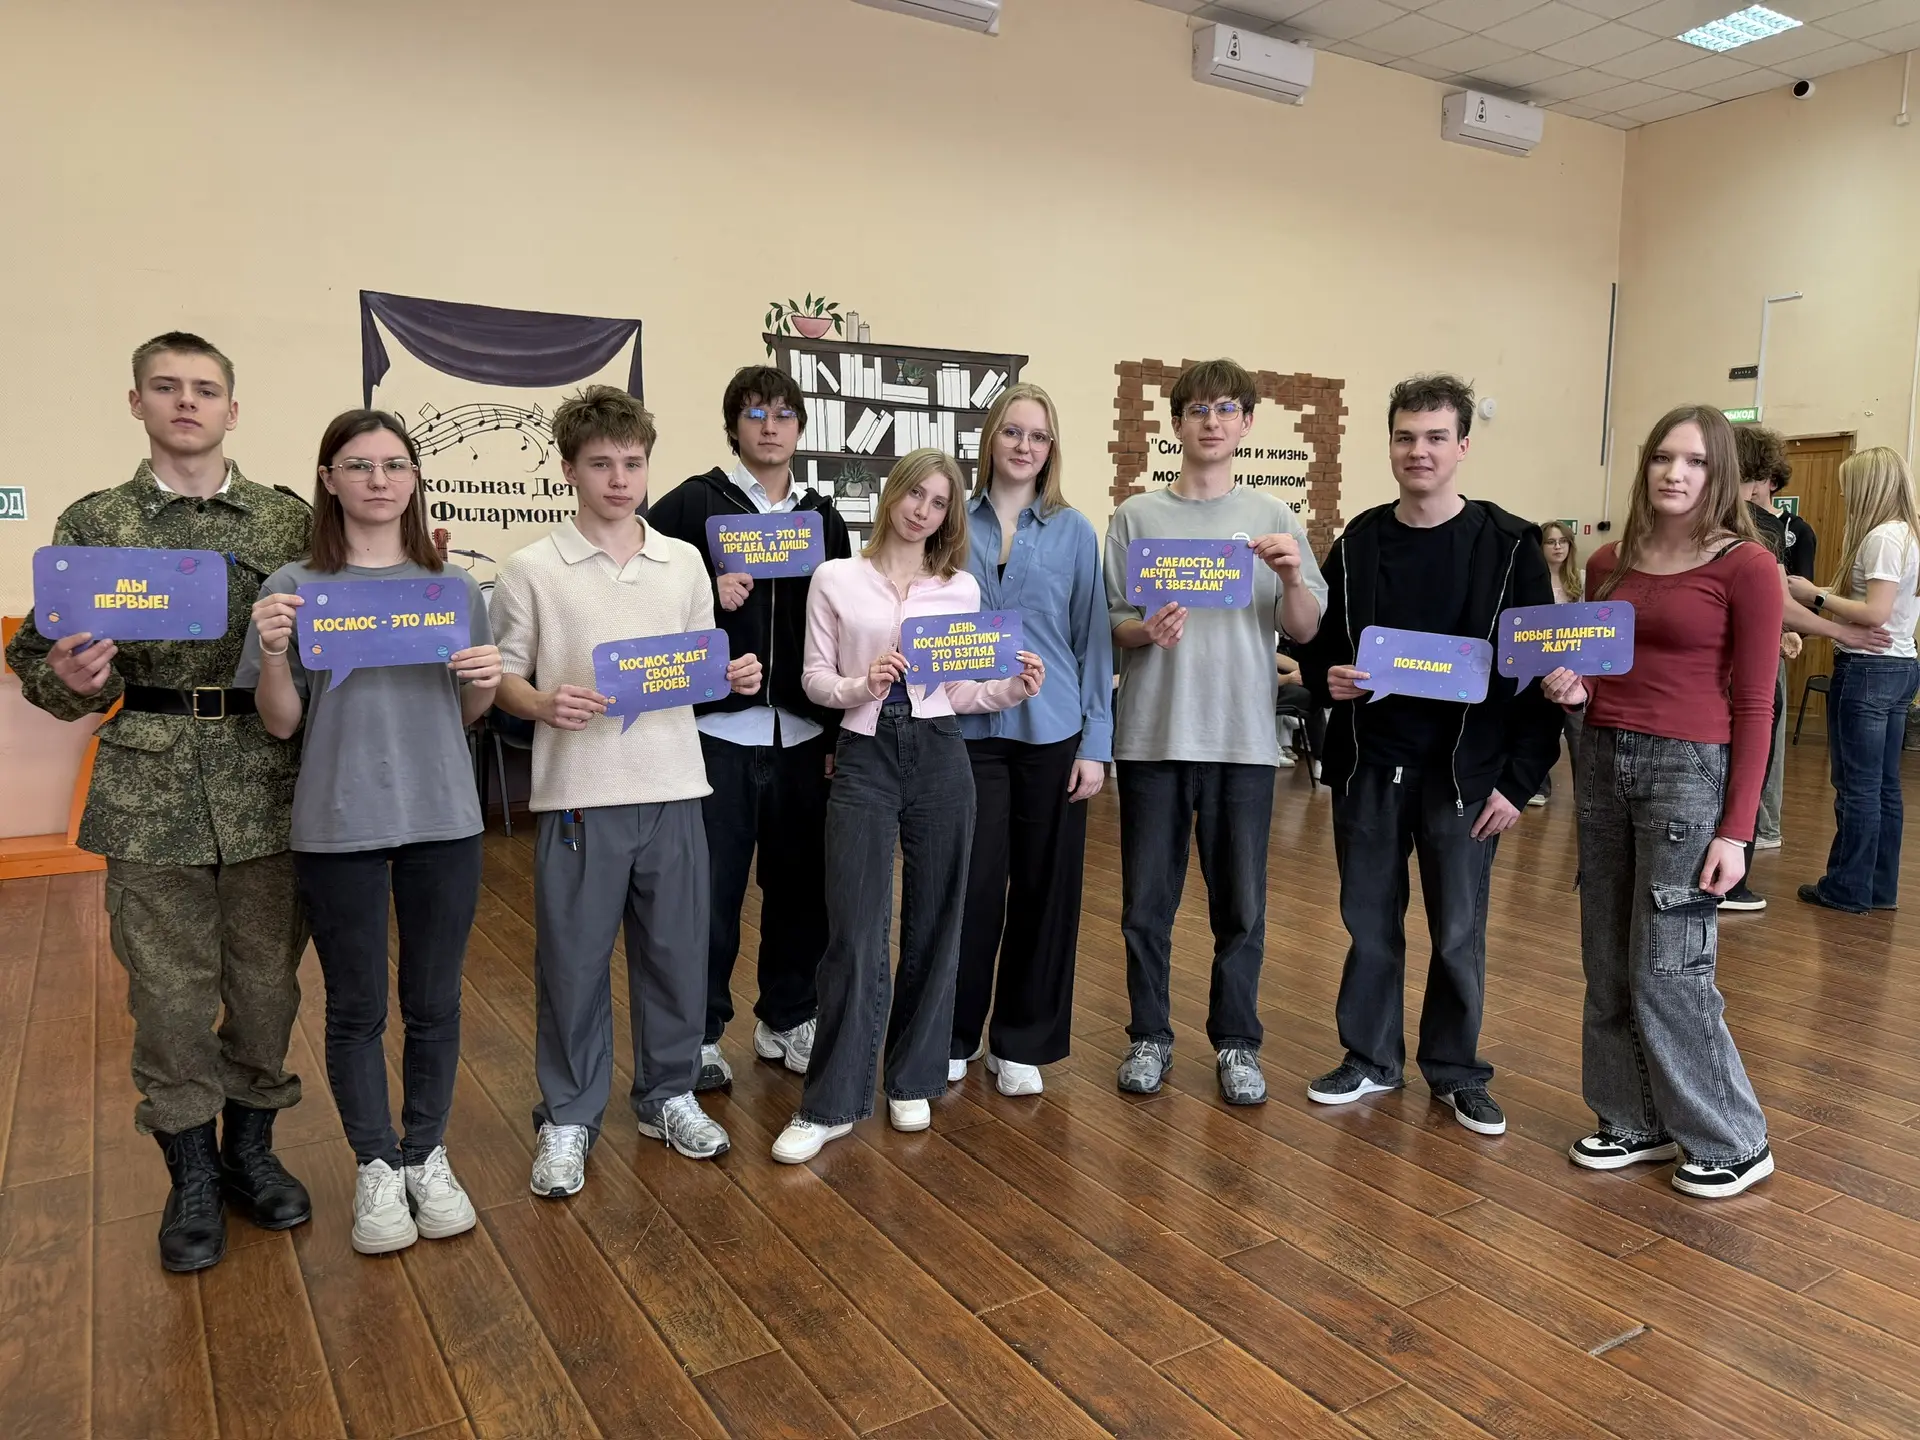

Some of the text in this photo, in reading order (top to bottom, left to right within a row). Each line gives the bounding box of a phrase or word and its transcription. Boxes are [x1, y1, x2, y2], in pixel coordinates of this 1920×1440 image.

[1151, 438, 1308, 461] "Сил ия и жизнь
[1246, 474, 1306, 488] целиком
[423, 477, 575, 501] кольная Дет
[430, 501, 577, 530] Филармон
[719, 531, 763, 543] КОСМОС
[776, 529, 796, 540] ЭТО
[798, 528, 811, 538] НЕ
[723, 540, 809, 554] ПРЕДЕЛ, А ЛИШЬ
[745, 552, 789, 564] НАЧАЛО!
[1156, 557, 1225, 568] СМЕЛОСТЬ И
[1140, 568, 1177, 579] МЕЧТА
[1199, 568, 1240, 580] КЛЮЧИ
[115, 579, 147, 593] МЫ
[1155, 580, 1223, 592] К ЗВЕЗДАМ!
[94, 593, 170, 609] ПЕРВЫЕ!
[313, 616, 377, 632] КОСМОС
[391, 613, 420, 628] ЭТО
[424, 611, 456, 625] МЫ!
[948, 622, 977, 634] ДЕНЬ
[913, 632, 1000, 649] КОСМОНАВТИКИ
[1514, 626, 1616, 642] НОВЫЕ ПЛАНЕТЫ
[931, 645, 995, 660] ЭТО ВЗГЛЯД
[1541, 638, 1582, 653] ЖДУТ!
[619, 648, 708, 671] КОСМОС ЖДЕТ
[932, 658, 995, 672] В БУДУЩЕЕ!
[1393, 657, 1453, 674] ПОЕХАЛИ!
[645, 664, 685, 680] СВОИХ
[642, 675, 690, 694] ГЕРОЕВ!
